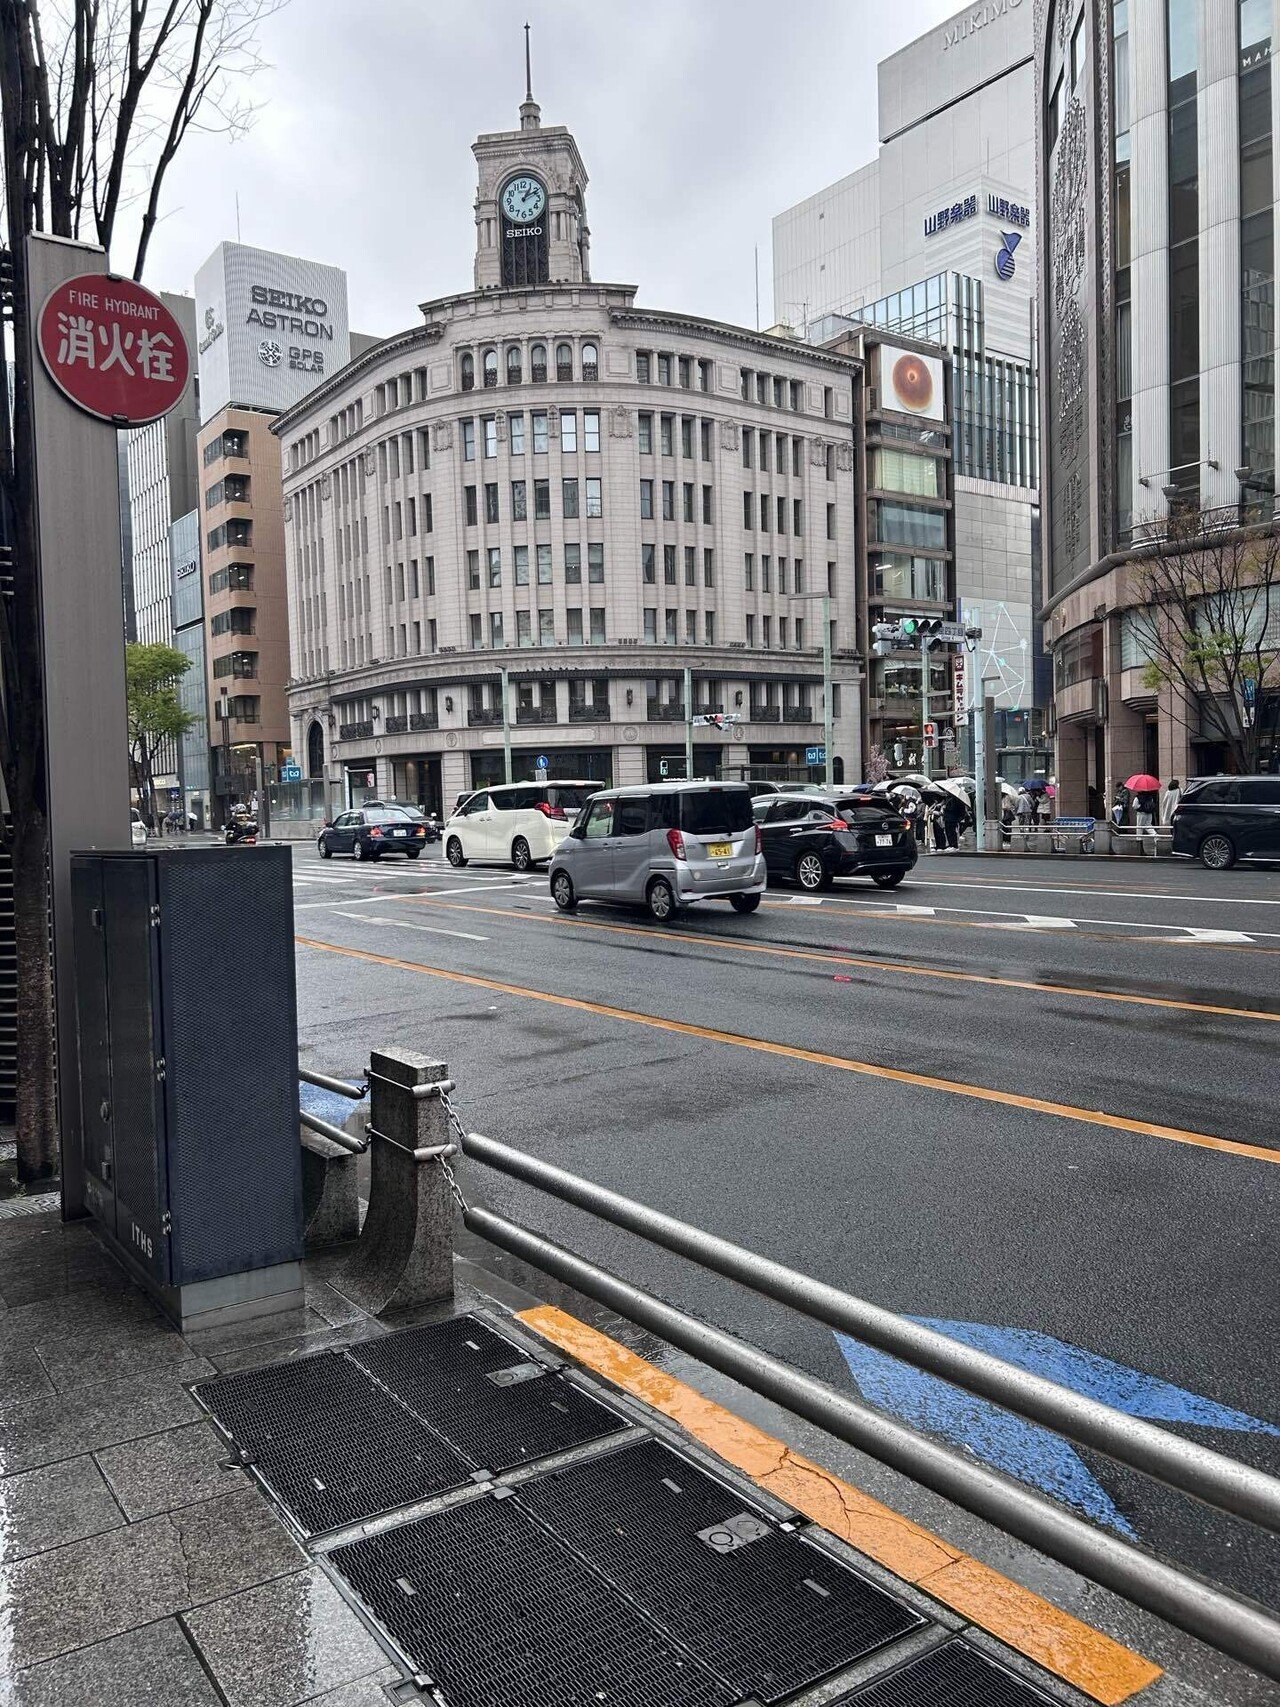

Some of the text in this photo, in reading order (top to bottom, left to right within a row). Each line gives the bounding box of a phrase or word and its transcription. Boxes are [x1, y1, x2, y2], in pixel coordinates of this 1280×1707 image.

[924, 194, 976, 237] 山野楽器
[988, 193, 1030, 227] 山野楽器
[506, 226, 543, 238] SEIKO
[69, 289, 160, 321] FIRE HYDRANT
[251, 284, 328, 317] SEIKO
[246, 308, 334, 341] ASTRON
[58, 311, 175, 382] 消火栓
[289, 346, 324, 364] GPS
[289, 360, 324, 374] SOLAR
[131, 1222, 153, 1259] ITHS
